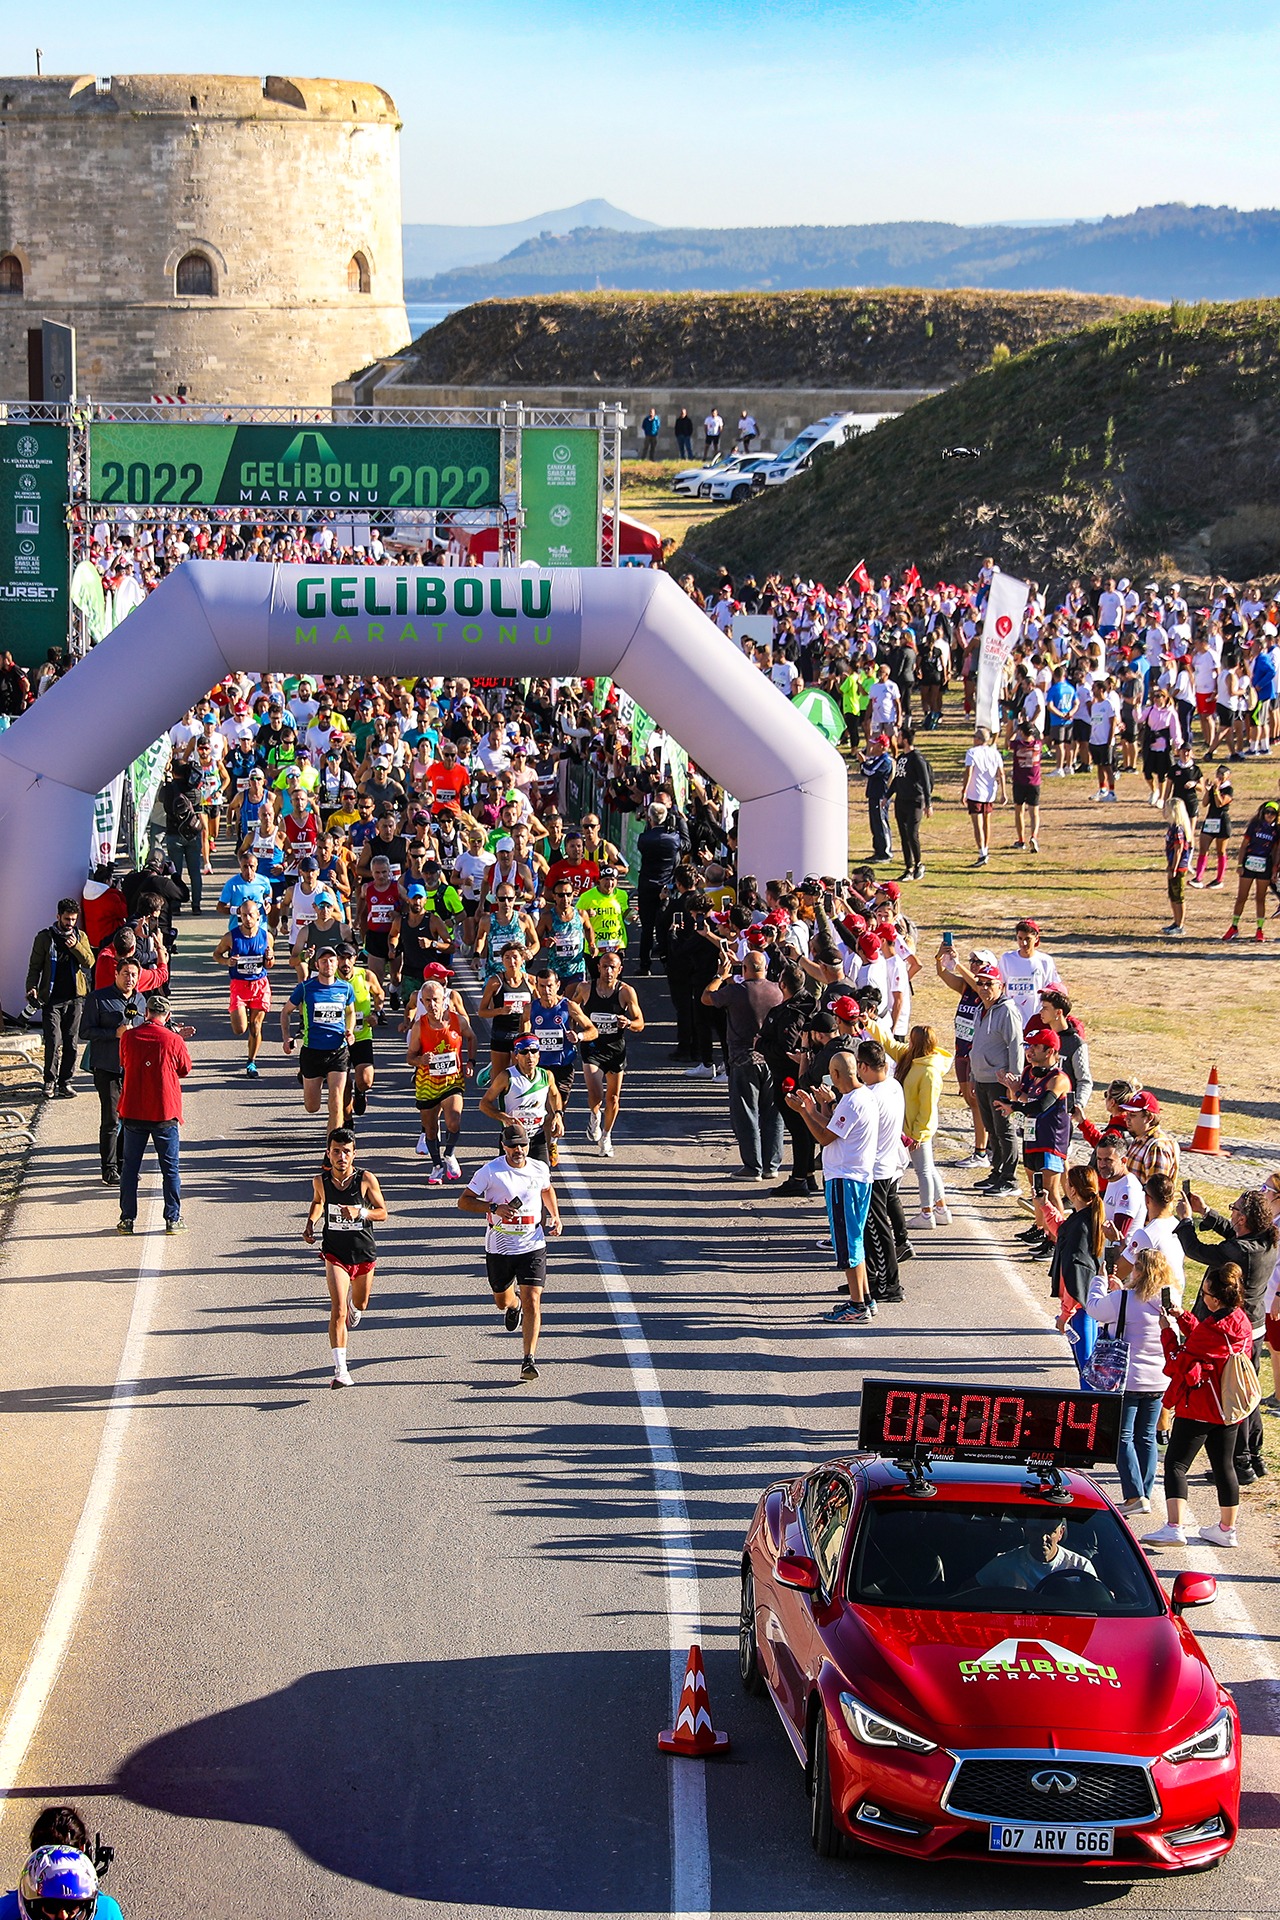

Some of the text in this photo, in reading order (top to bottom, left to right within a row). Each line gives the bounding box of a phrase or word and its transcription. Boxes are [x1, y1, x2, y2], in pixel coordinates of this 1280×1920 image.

[102, 462, 203, 503] 2022
[388, 466, 490, 507] 2022
[240, 490, 378, 503] MARATONU
[295, 622, 552, 645] MARATONU
[541, 1037, 558, 1045] 630
[883, 1391, 1099, 1450] 00:00:14
[964, 1452, 1016, 1460] www.plustiming.com
[1031, 1452, 1055, 1460] PLUS
[962, 1672, 1122, 1689] MARATONU
[1002, 1829, 1025, 1848] 07
[1033, 1830, 1067, 1850] ARV
[1076, 1832, 1109, 1851] 666
